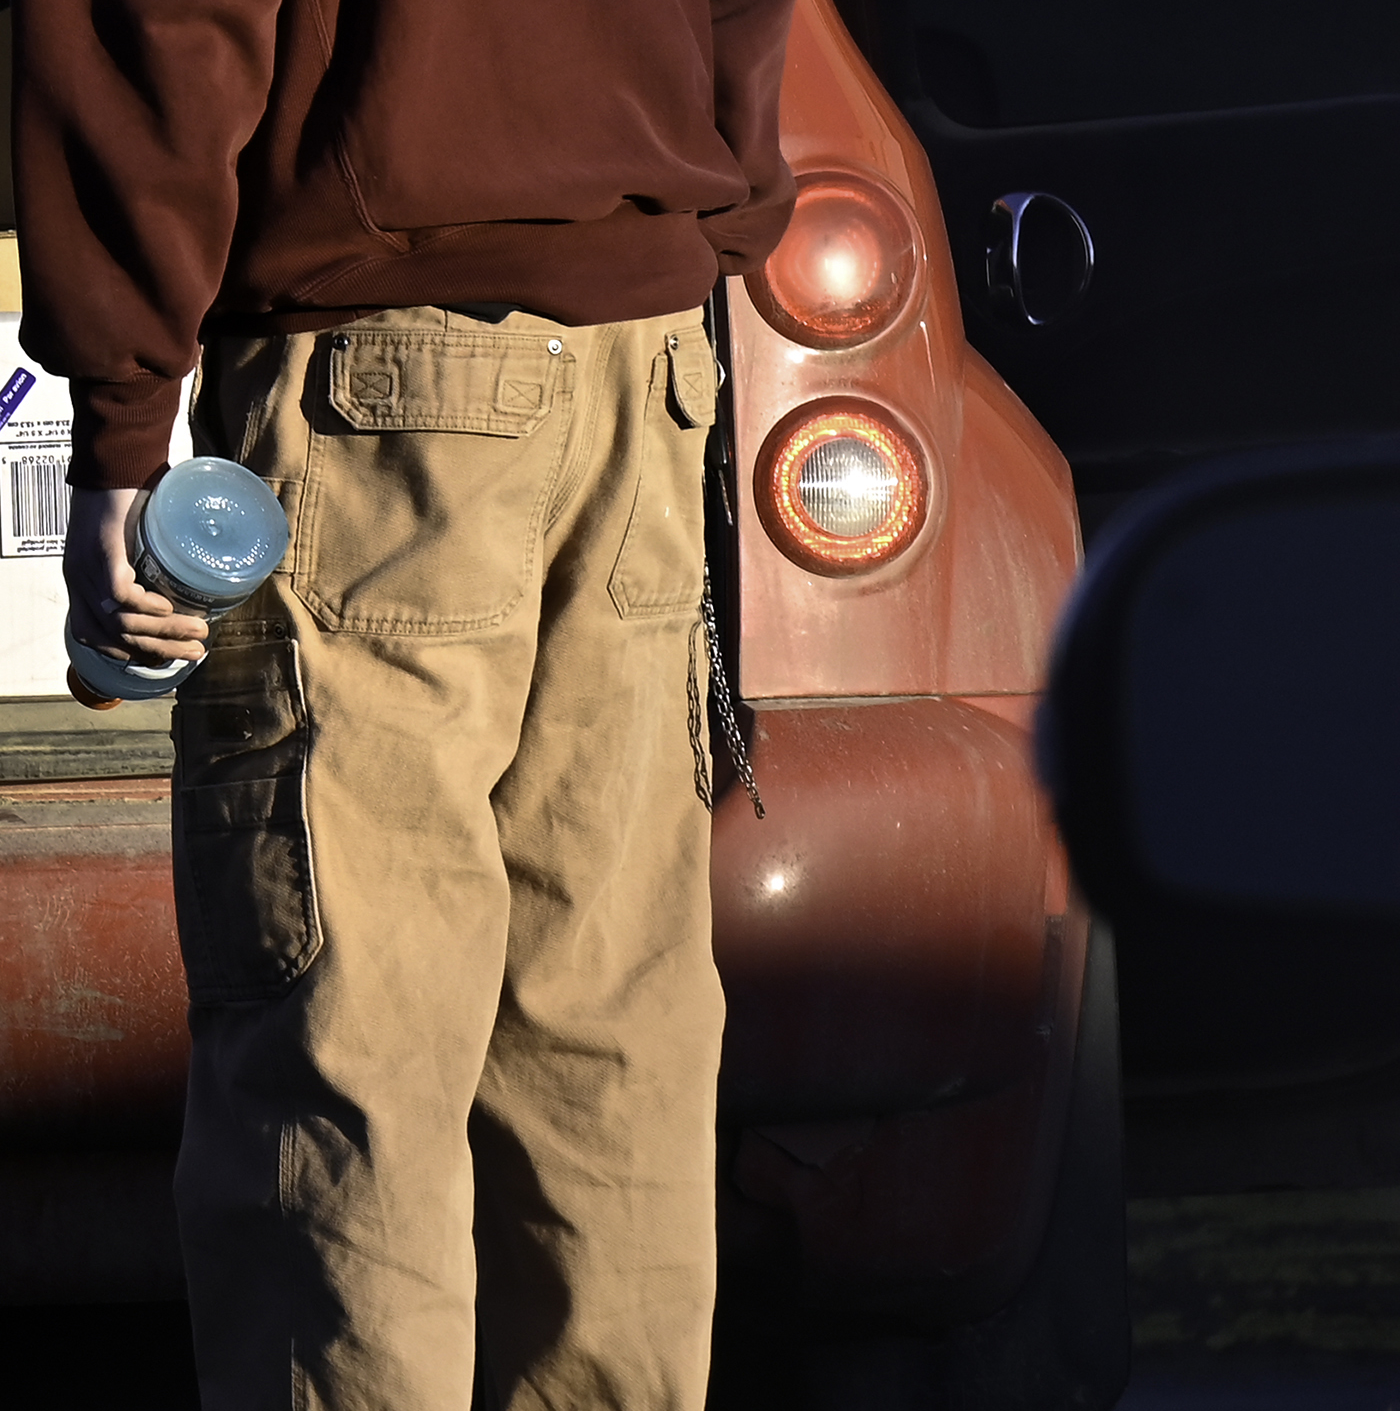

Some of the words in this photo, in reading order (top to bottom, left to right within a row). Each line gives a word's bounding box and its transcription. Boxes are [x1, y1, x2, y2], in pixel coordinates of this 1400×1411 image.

[2, 390, 14, 405] Par
[12, 372, 28, 394] avion
[21, 455, 54, 464] 02268
